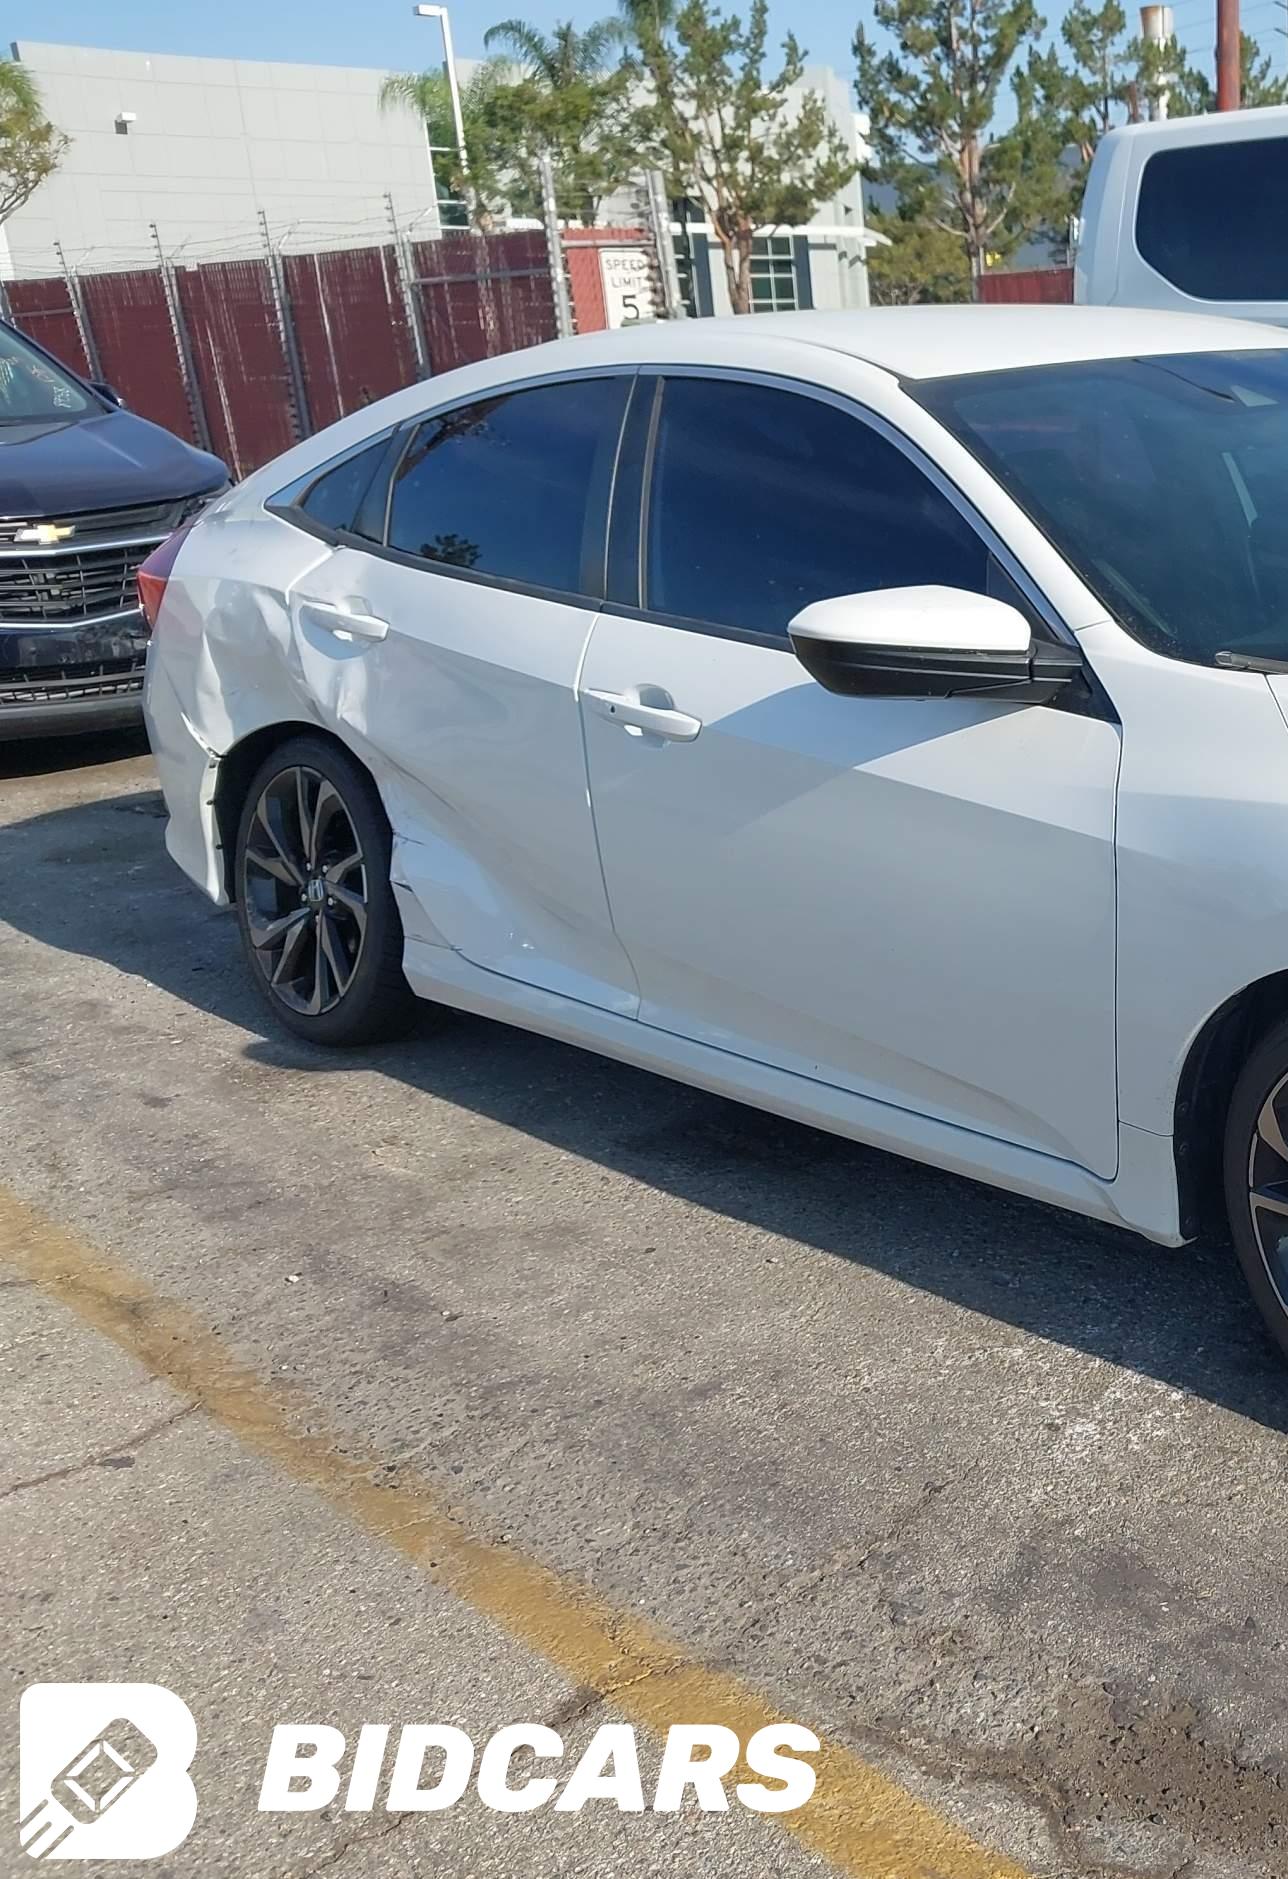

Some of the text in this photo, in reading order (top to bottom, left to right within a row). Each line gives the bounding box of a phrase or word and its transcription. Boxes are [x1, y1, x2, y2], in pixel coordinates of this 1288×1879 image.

[606, 258, 645, 271] SPEED
[611, 276, 643, 289] LIMIT
[622, 294, 639, 320] 5
